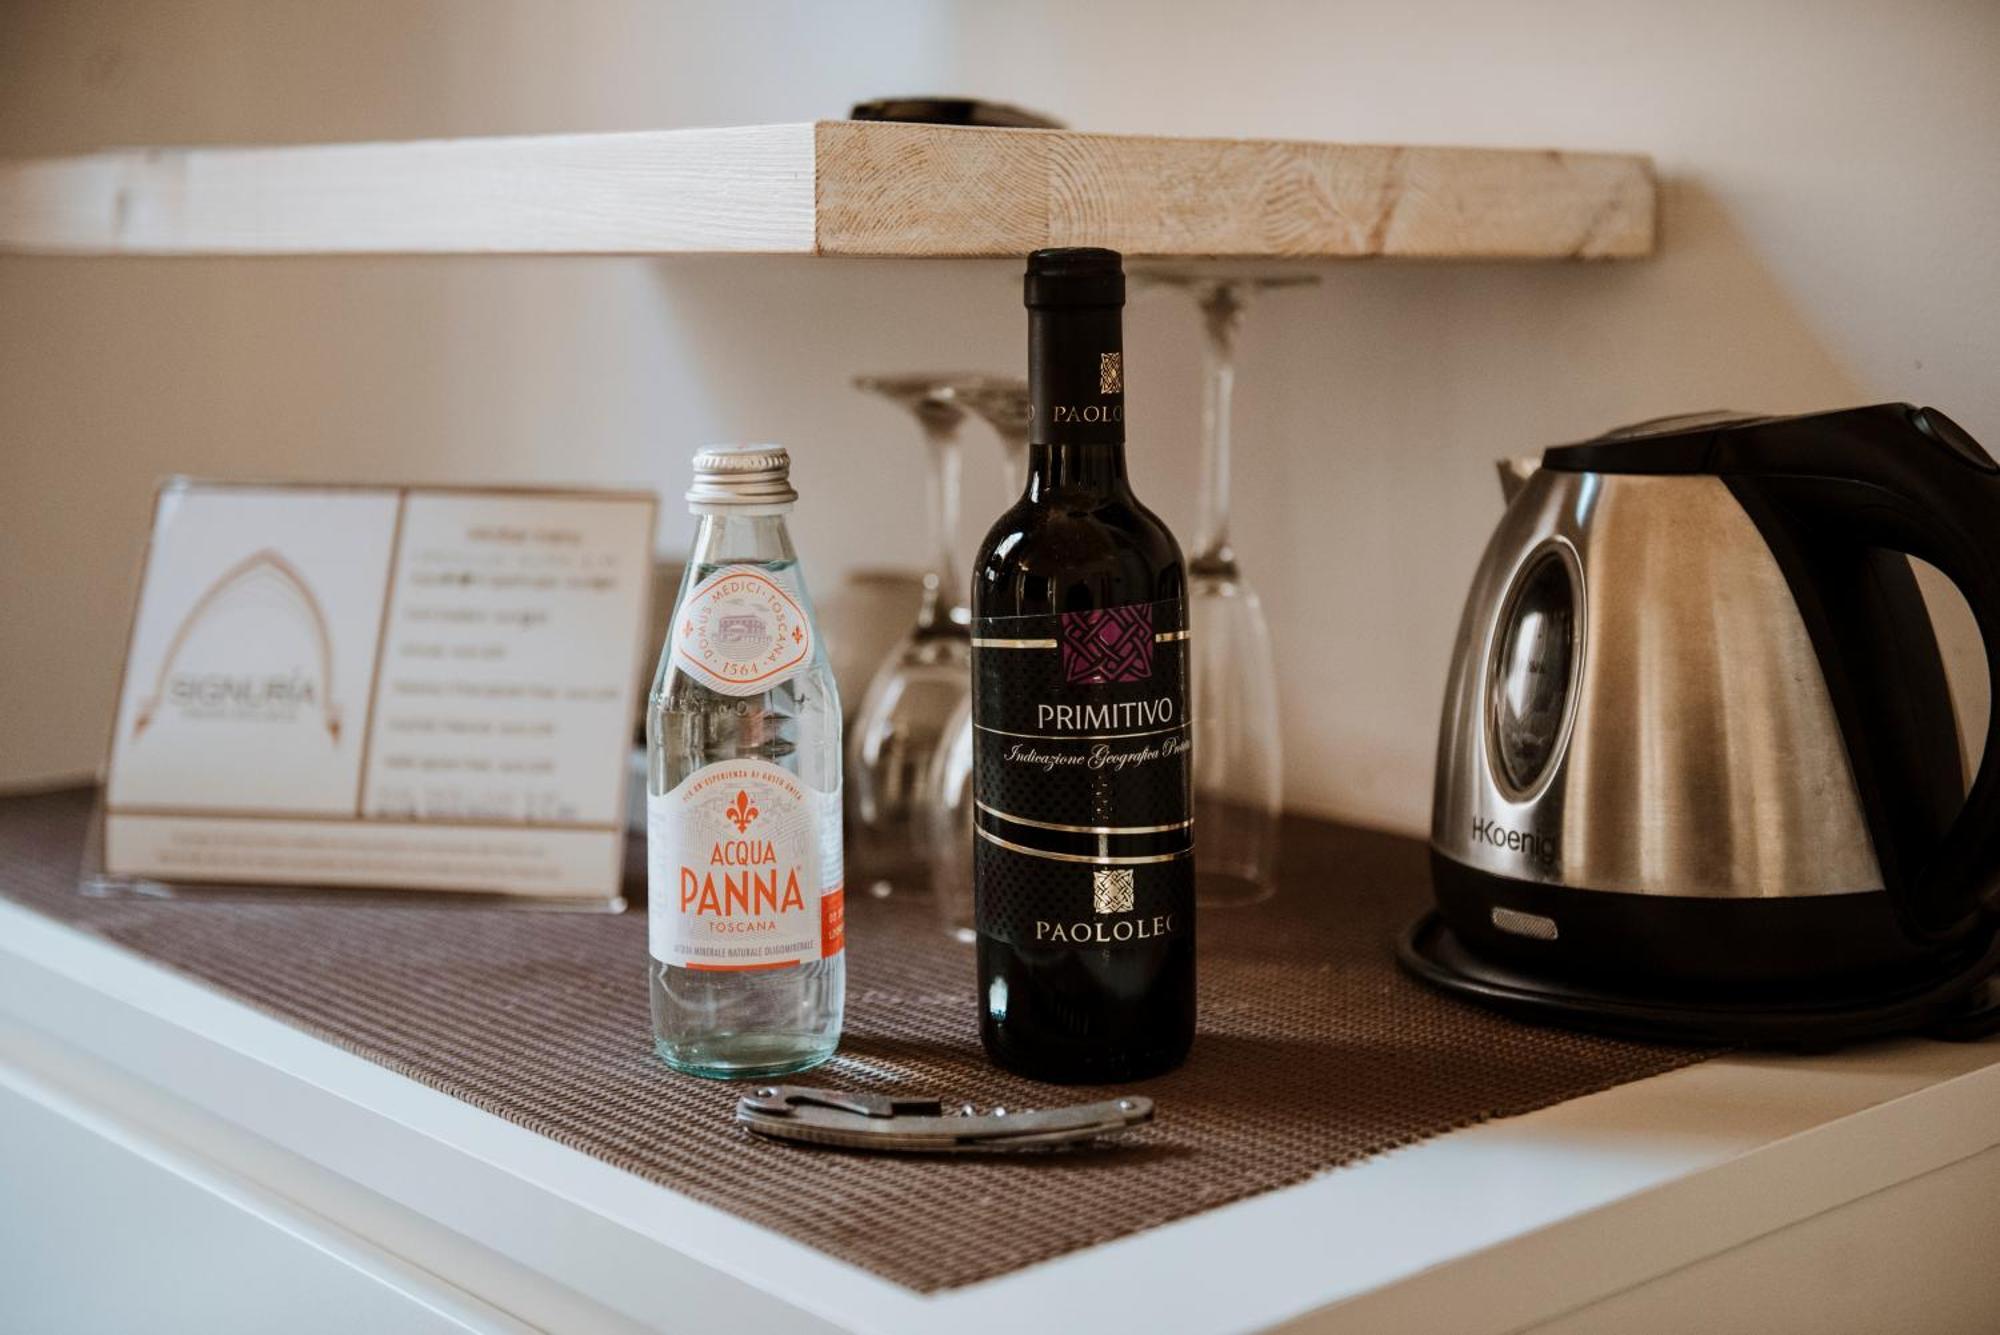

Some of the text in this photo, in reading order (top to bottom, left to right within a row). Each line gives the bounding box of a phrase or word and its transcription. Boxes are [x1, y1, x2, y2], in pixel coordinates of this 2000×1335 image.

[698, 581, 789, 662] DOMUS MEDICI TOSCANA
[721, 661, 760, 676] 1564
[1037, 697, 1173, 731] PRIMITIVO
[1004, 743, 1085, 771] Indicazione
[1087, 743, 1160, 771] Geografica
[710, 840, 777, 865] ACQUA
[680, 867, 804, 917] PANNA
[709, 920, 777, 934] TOSCANA
